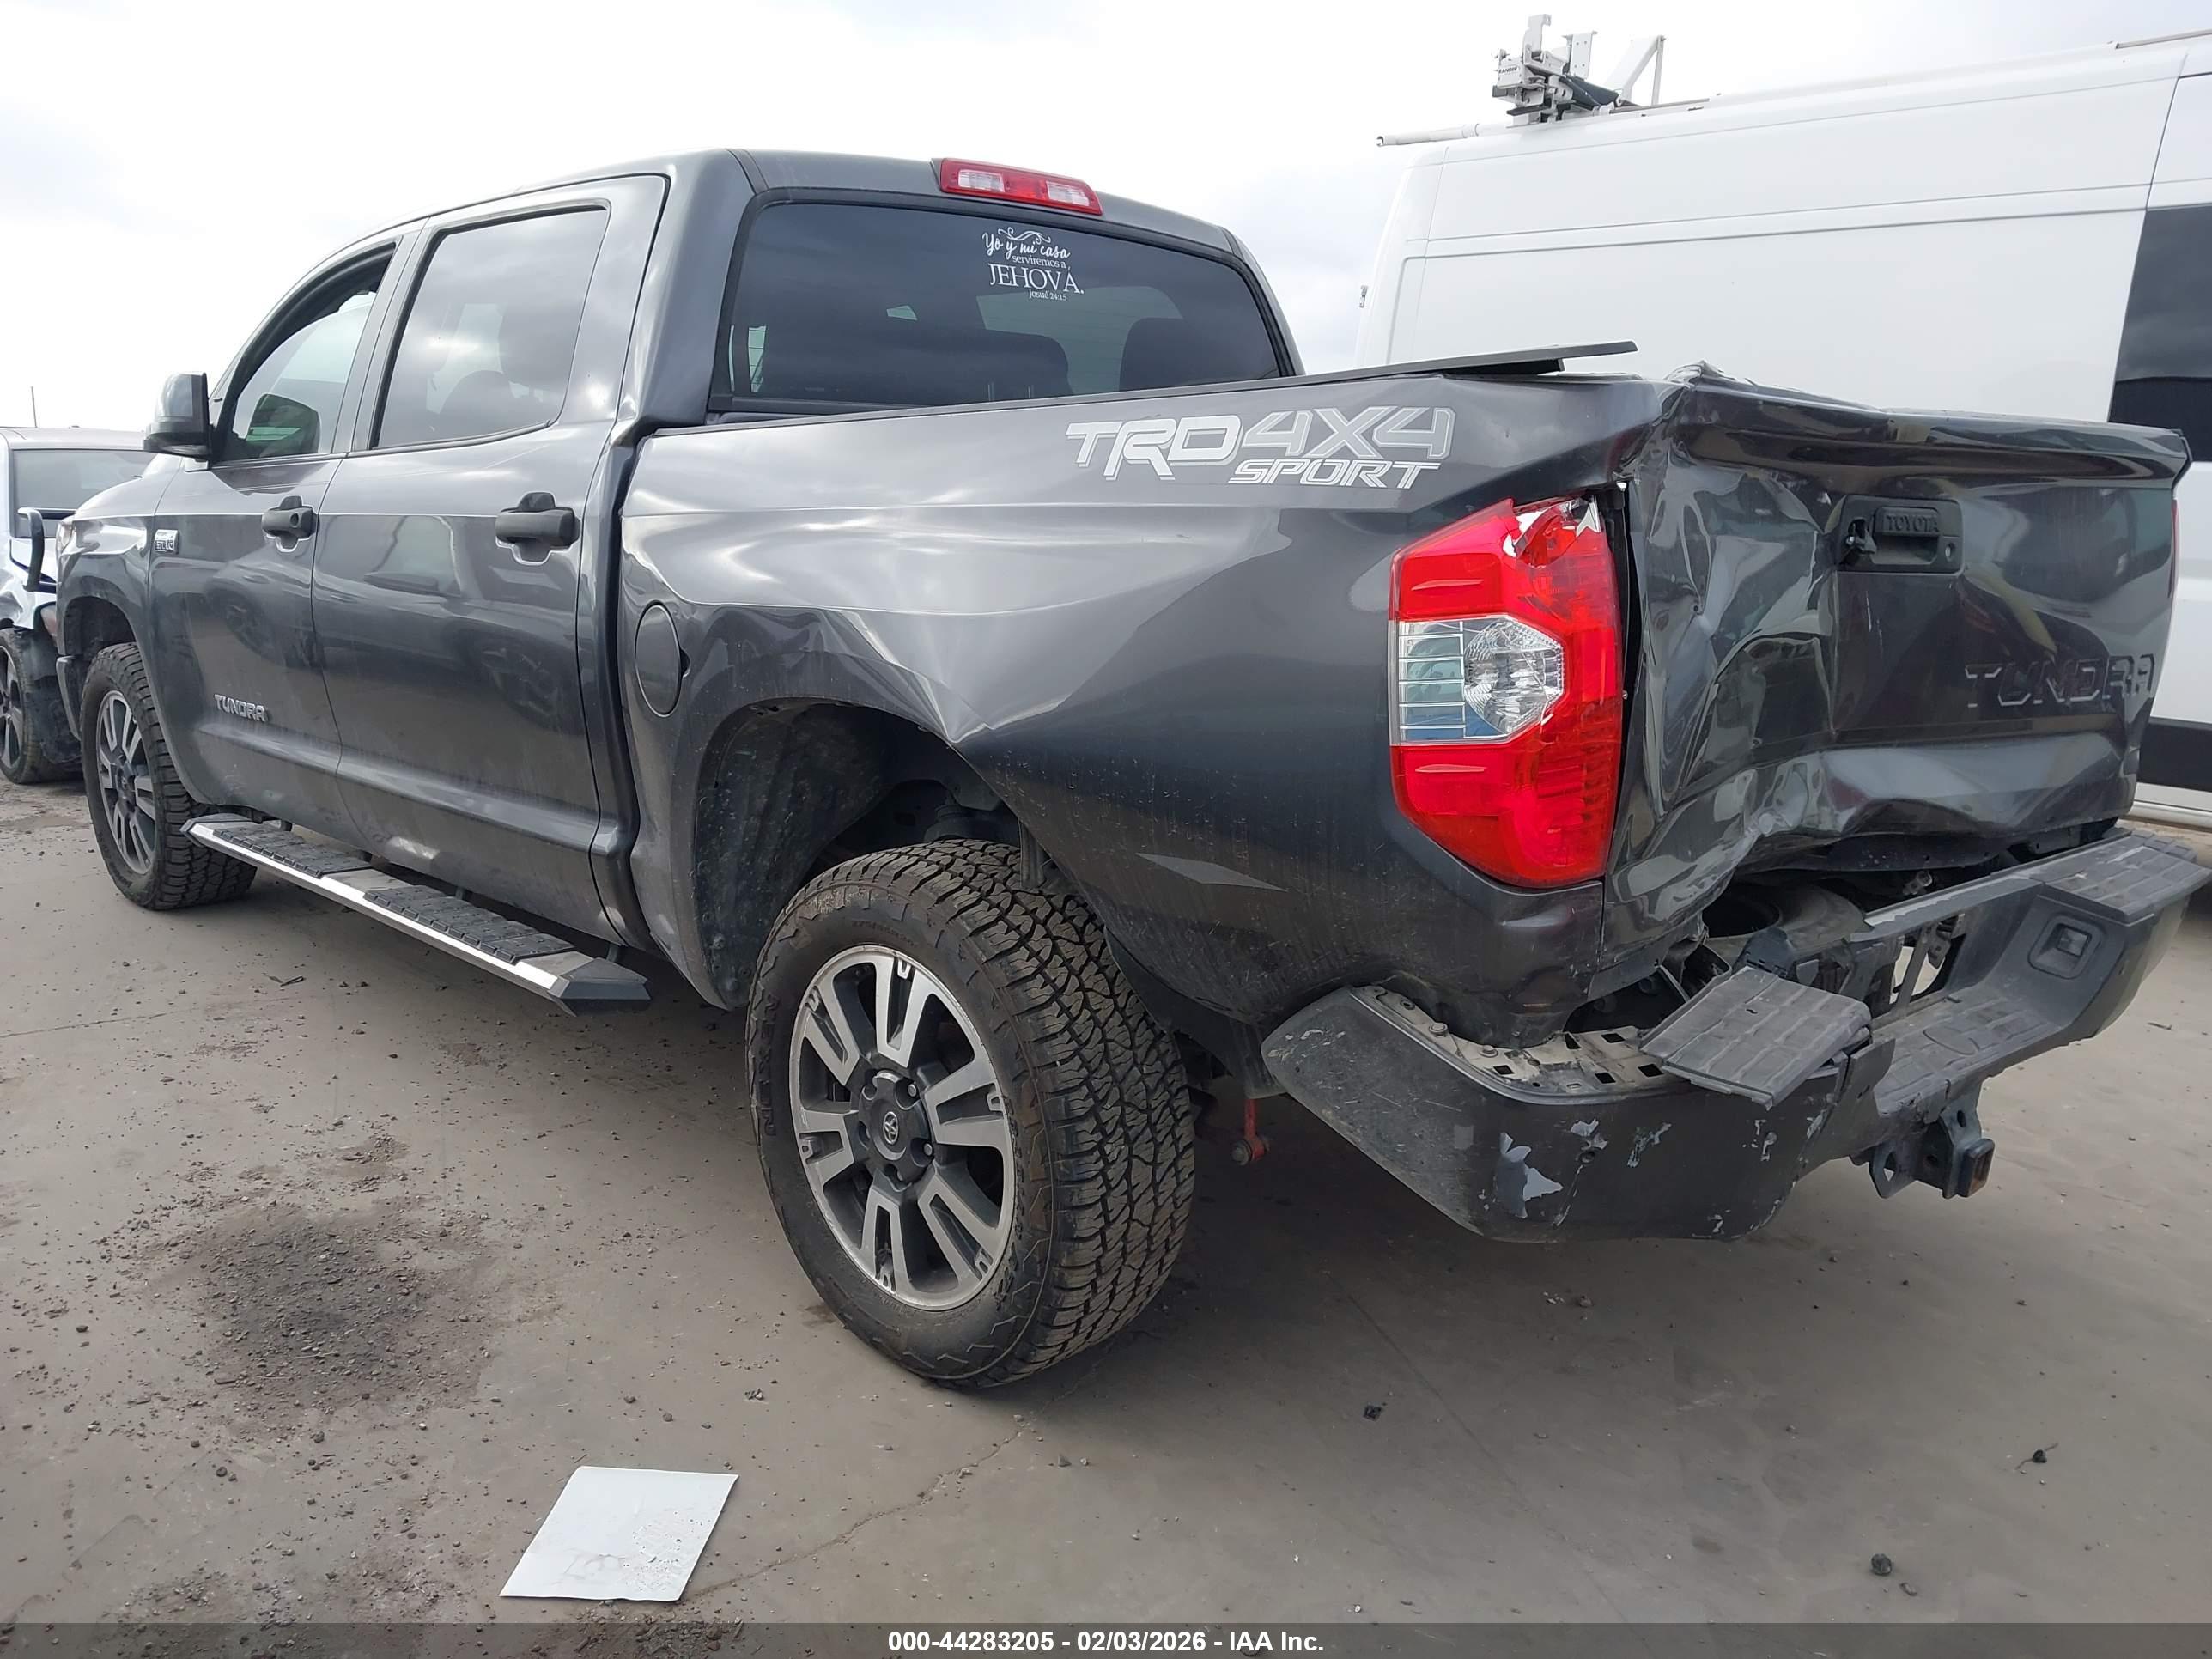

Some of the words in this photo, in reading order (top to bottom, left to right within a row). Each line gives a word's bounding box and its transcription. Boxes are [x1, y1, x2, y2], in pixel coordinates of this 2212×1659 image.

[981, 233, 1003, 256] Yo
[1006, 242, 1017, 259] y
[1019, 241, 1037, 253] mi
[1040, 246, 1070, 258] casa
[1012, 255, 1060, 268] serviremos
[1066, 415, 1243, 481] TRD
[1227, 458, 1442, 489] SPORT
[1887, 514, 1940, 534] TOYOTA
[214, 693, 268, 723] TUNDRA
